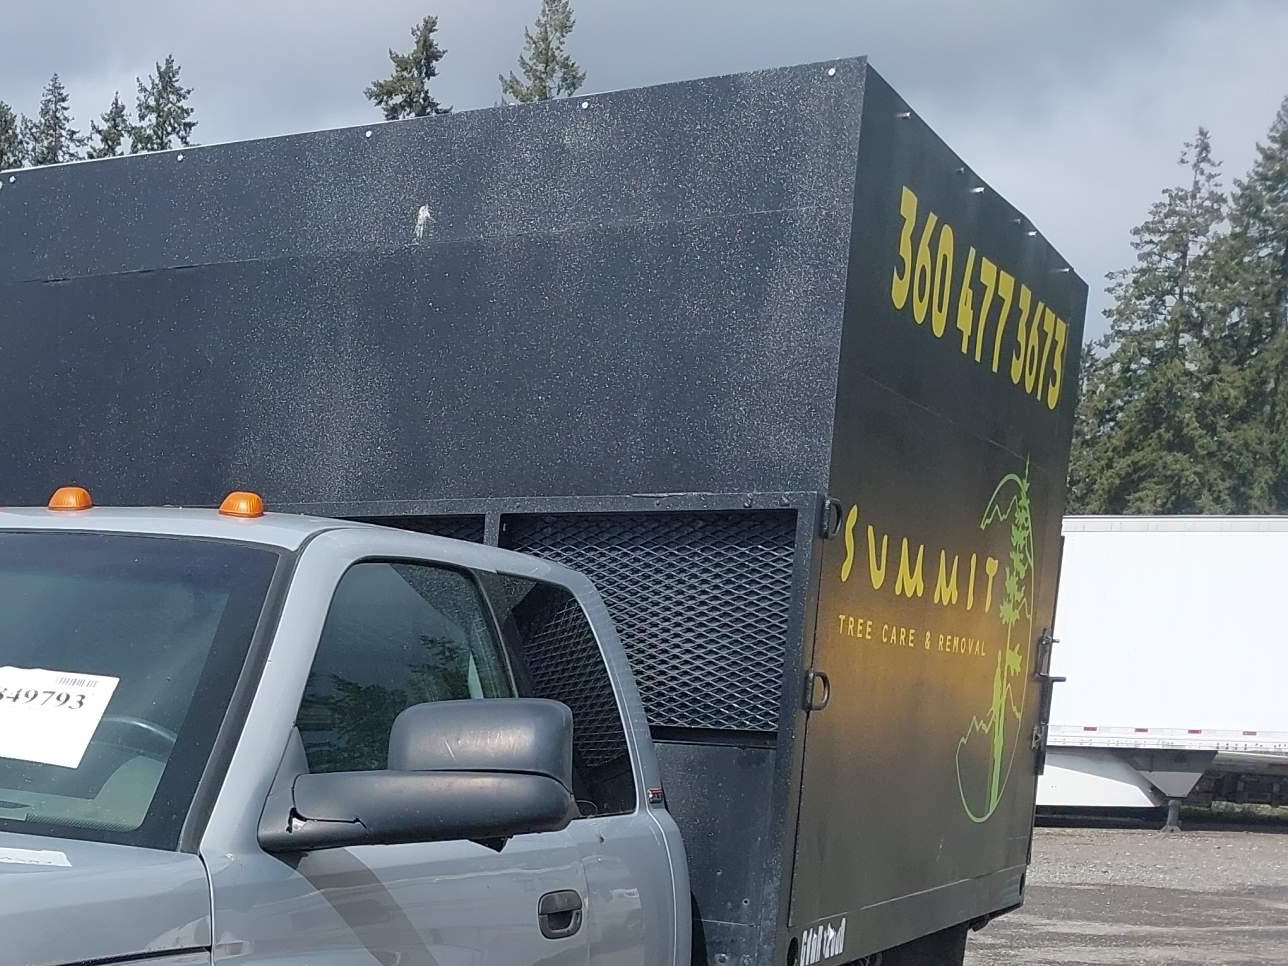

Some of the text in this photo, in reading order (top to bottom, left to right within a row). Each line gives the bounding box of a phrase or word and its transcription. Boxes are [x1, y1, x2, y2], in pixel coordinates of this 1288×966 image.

[891, 184, 1068, 411] 360 477 3673
[840, 503, 999, 614] SUMMIT
[838, 614, 987, 657] TREE CARE & REMOVAL
